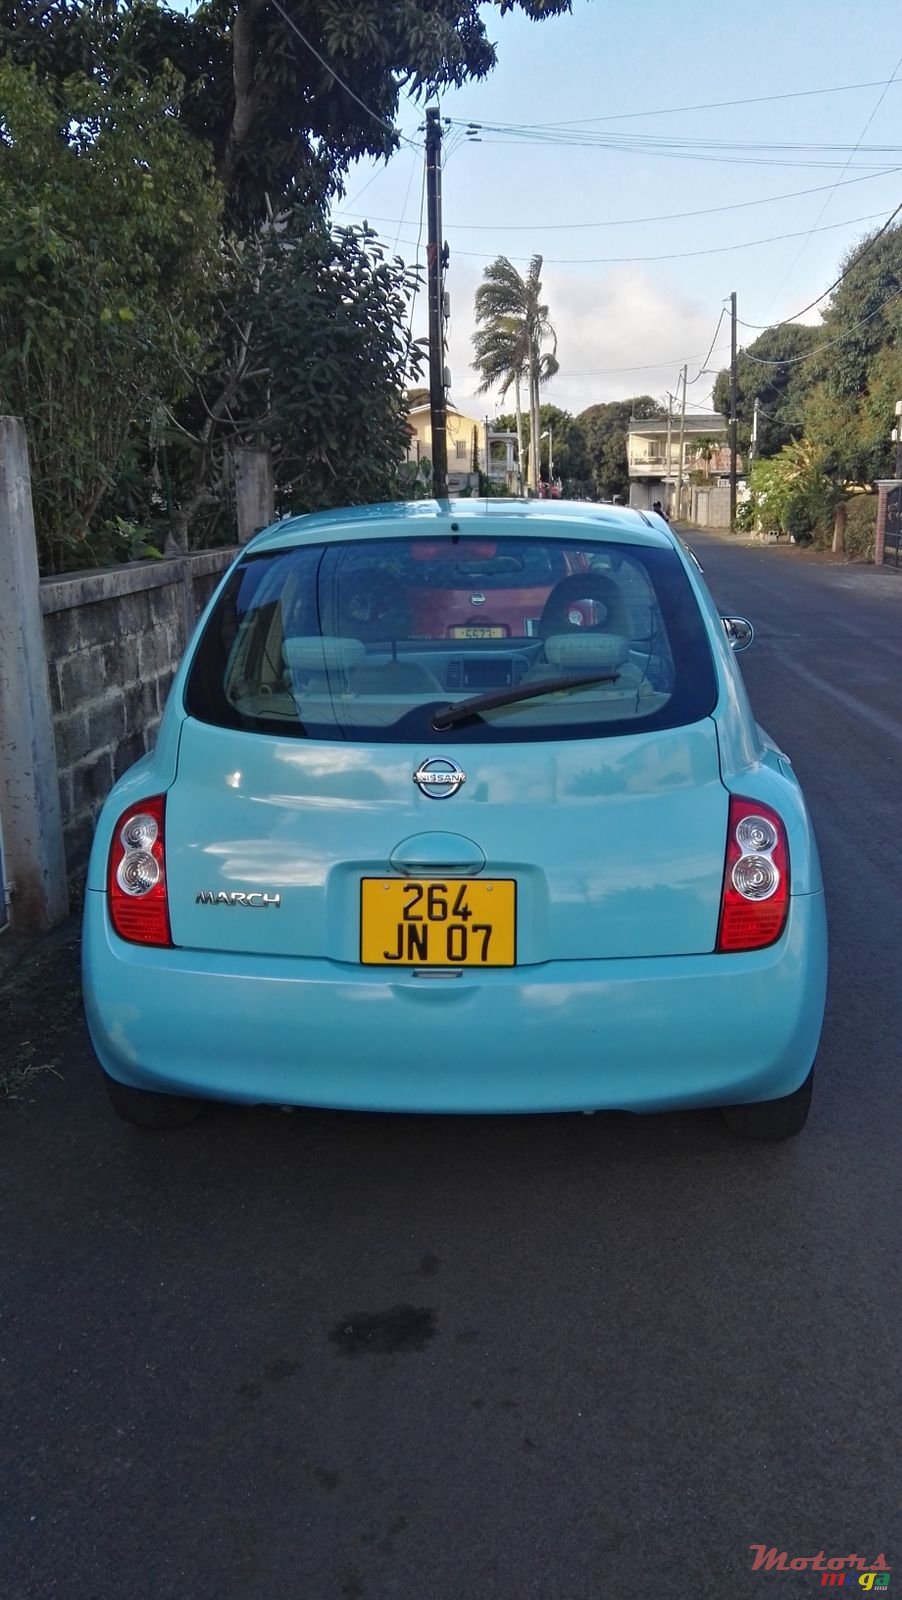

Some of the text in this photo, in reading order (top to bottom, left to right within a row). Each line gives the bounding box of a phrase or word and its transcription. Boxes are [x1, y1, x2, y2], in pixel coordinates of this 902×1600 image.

[419, 774, 460, 782] NISSAN
[195, 891, 281, 908] MARCH
[403, 883, 472, 921] 264
[384, 923, 492, 961] JN 07
